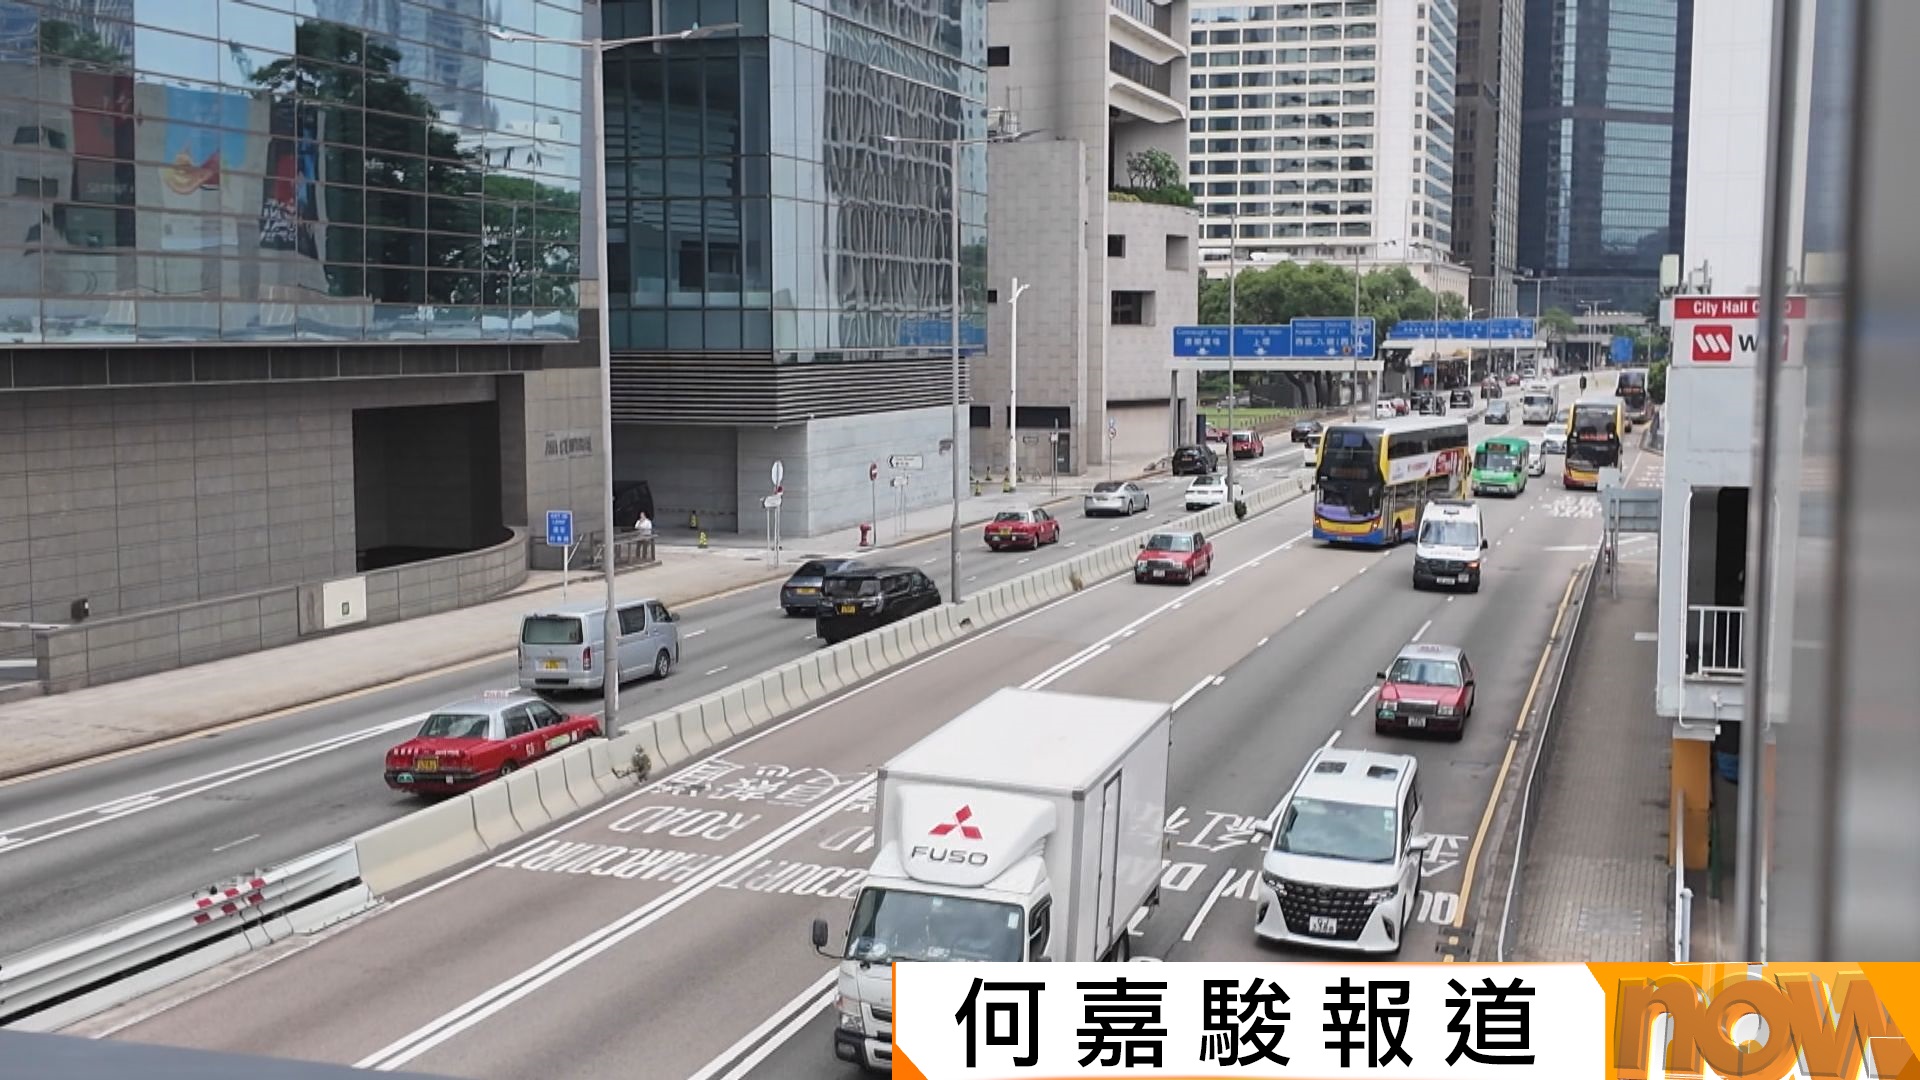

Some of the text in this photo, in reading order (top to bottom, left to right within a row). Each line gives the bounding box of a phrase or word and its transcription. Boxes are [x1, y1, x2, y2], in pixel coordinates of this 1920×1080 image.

[1693, 301, 1718, 317] City
[1722, 301, 1748, 314] Hall
[608, 805, 762, 841] ROAD
[496, 840, 723, 883] HARCOURT
[911, 846, 989, 867] FUSO
